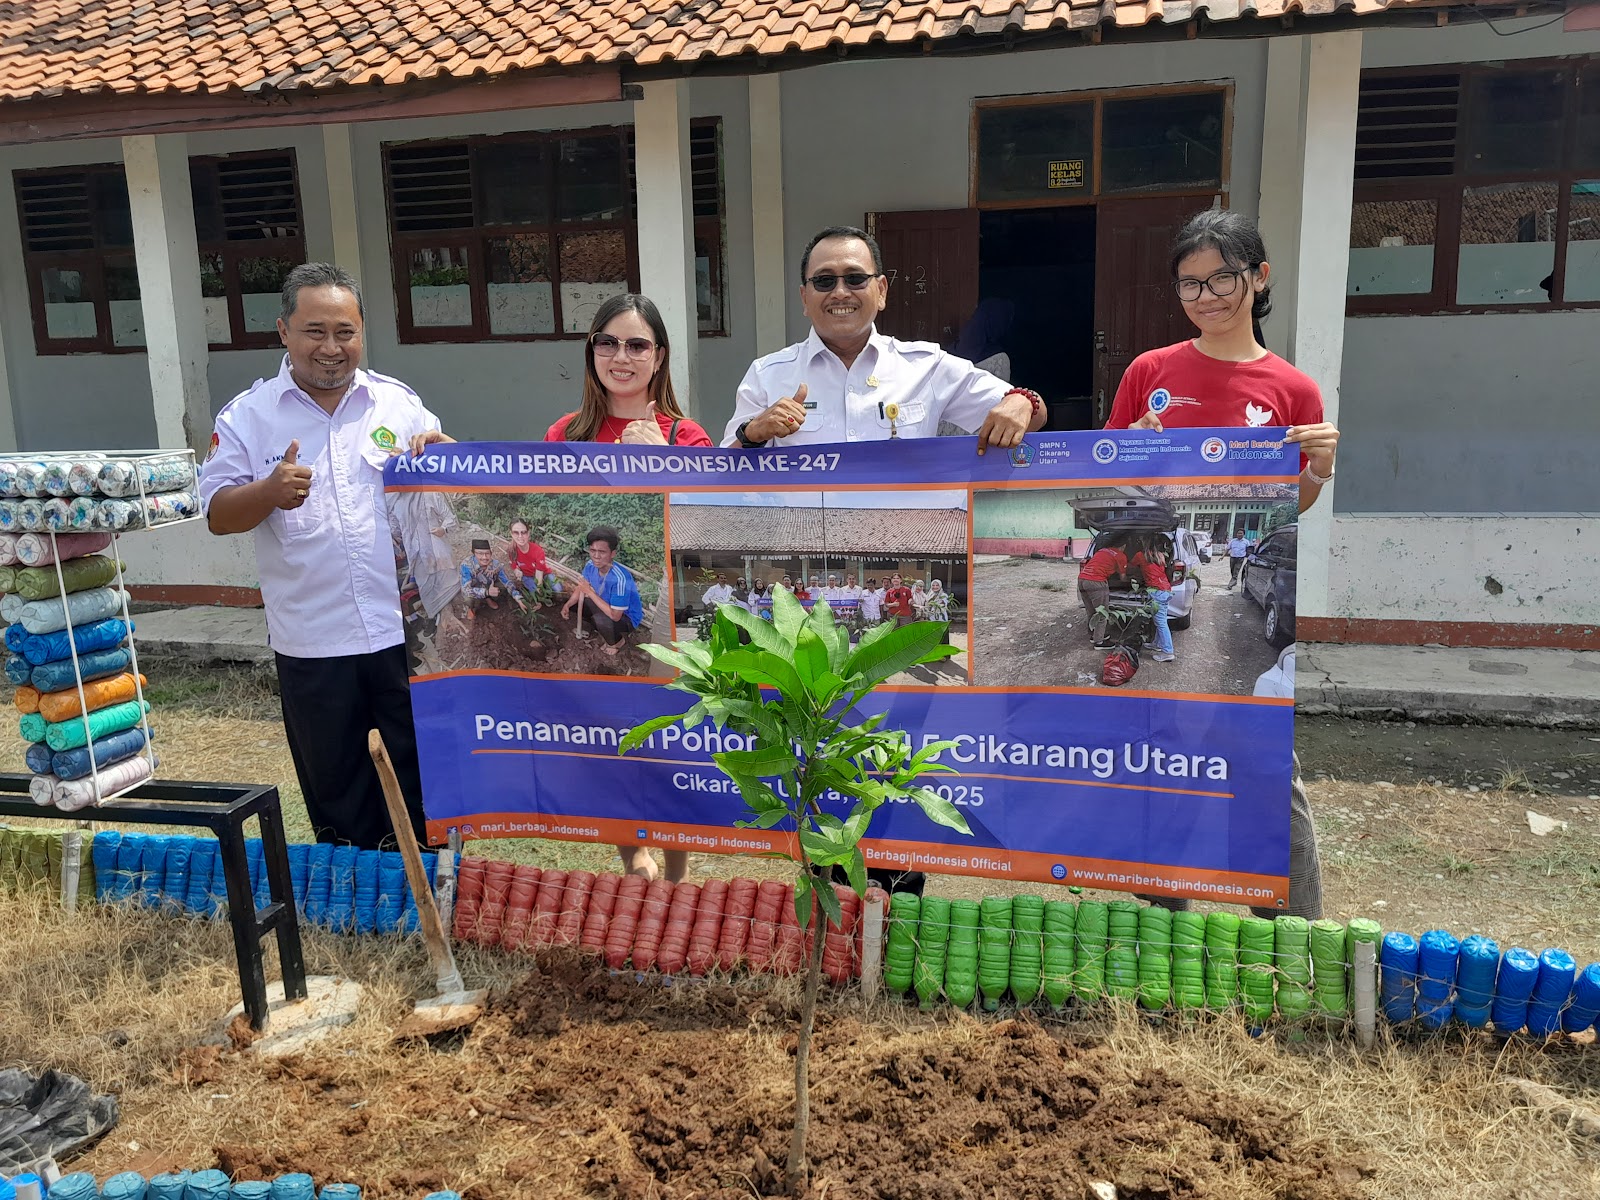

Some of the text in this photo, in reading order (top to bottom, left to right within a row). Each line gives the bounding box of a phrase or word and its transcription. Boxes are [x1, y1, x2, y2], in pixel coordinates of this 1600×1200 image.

[1051, 162, 1081, 171] RUANG
[1051, 170, 1081, 178] KELAS
[1039, 450, 1070, 458] Cikarang
[1229, 440, 1283, 449] Mari Berbagi
[1229, 449, 1284, 459] Indonesia
[395, 453, 841, 473] AKSI MARI BERBAGI INDONESIA KE-247
[950, 734, 1114, 778] Cikarang
[1124, 743, 1228, 780] Utara
[672, 772, 773, 800] Cikara
[920, 784, 984, 806] 025
[481, 822, 599, 836] mari_berbagi_indonesia
[652, 831, 675, 842] Mari
[678, 834, 718, 847] Berbagi
[721, 837, 772, 850] Indonesia
[866, 848, 910, 864] Berbagi
[912, 852, 968, 867] Indonesia
[971, 857, 1012, 872] Official
[1073, 868, 1274, 898] www.mariberbagiindonesia.com
